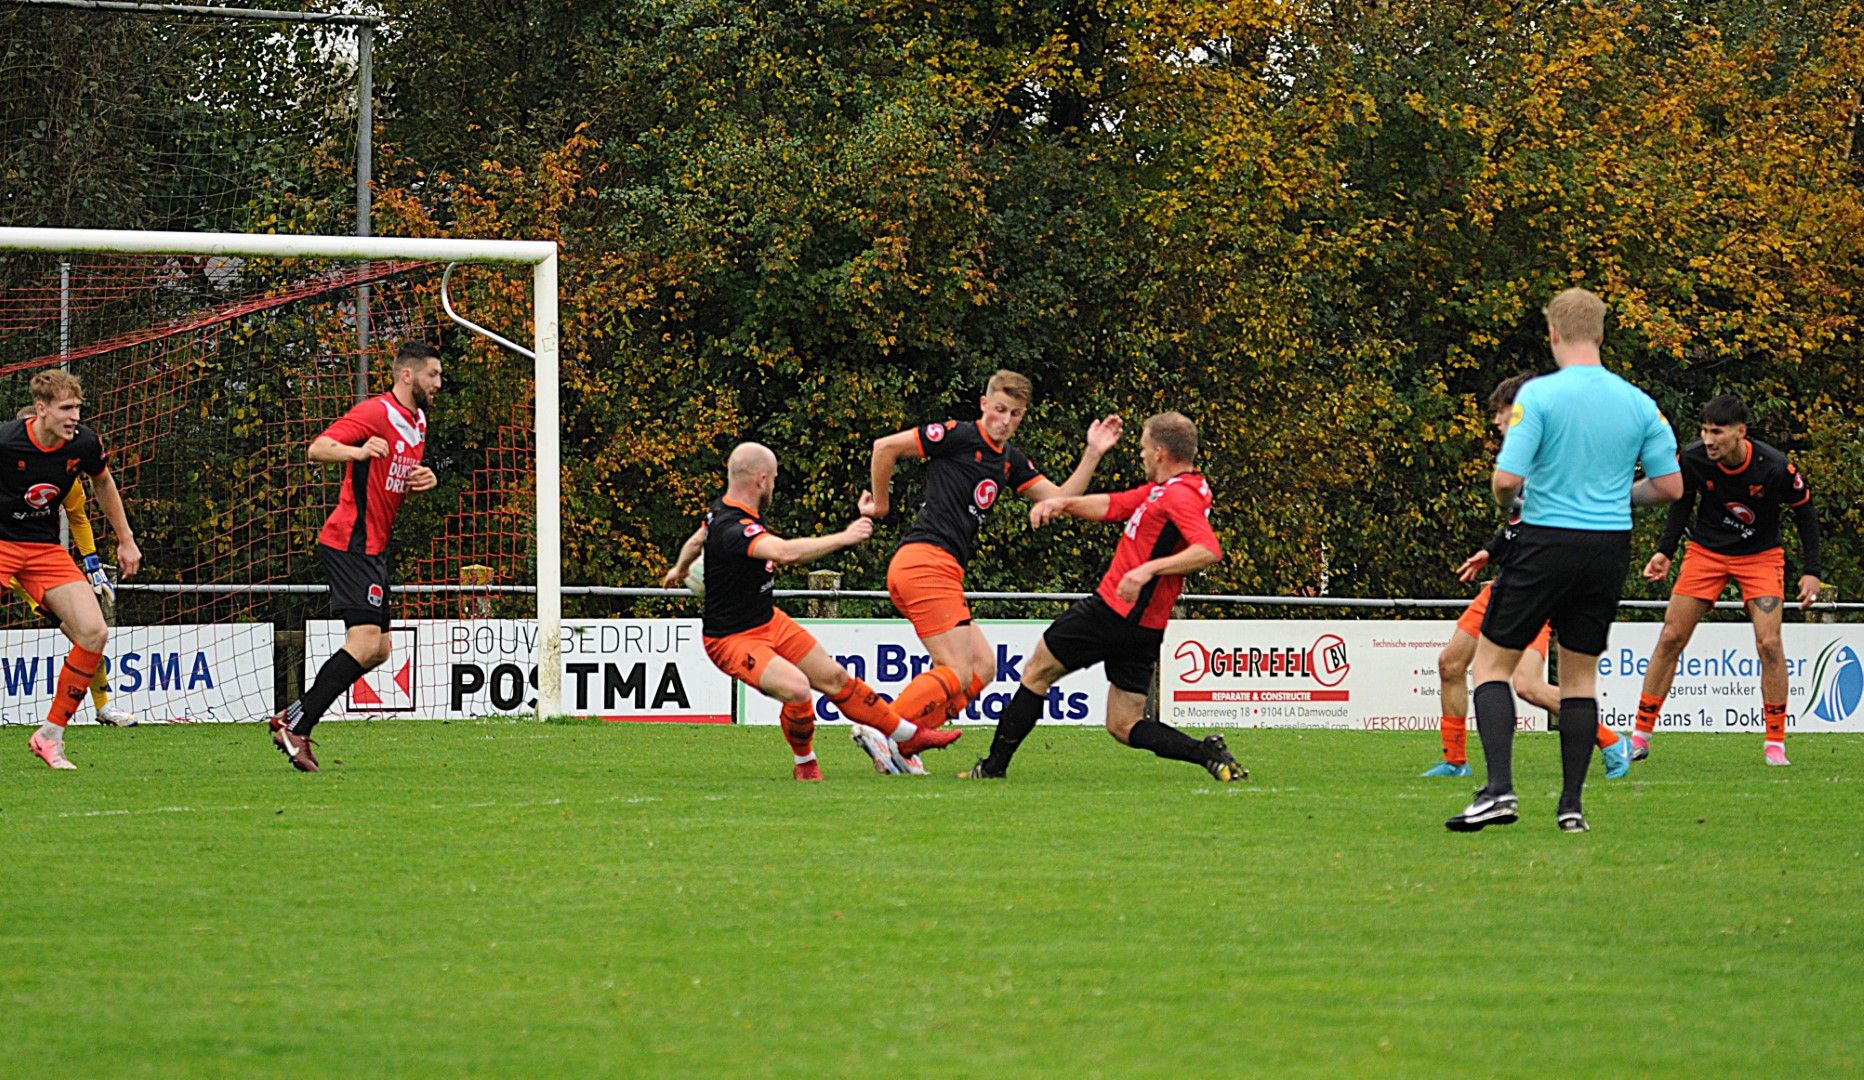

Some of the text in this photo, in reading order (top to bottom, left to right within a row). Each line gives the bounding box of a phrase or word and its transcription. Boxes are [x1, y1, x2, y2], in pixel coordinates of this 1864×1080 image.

[1373, 639, 1406, 648] Technische
[1211, 642, 1347, 678] GEREEL BV
[2, 651, 214, 696] WISMA
[1421, 687, 1435, 696] licht
[1711, 682, 1756, 696] wakker
[1212, 692, 1250, 701] REPARATIE
[1261, 692, 1311, 701] CONSTRUCTIE
[1173, 707, 1348, 719] De Moarreweg 18 9104 LA Damwoude
